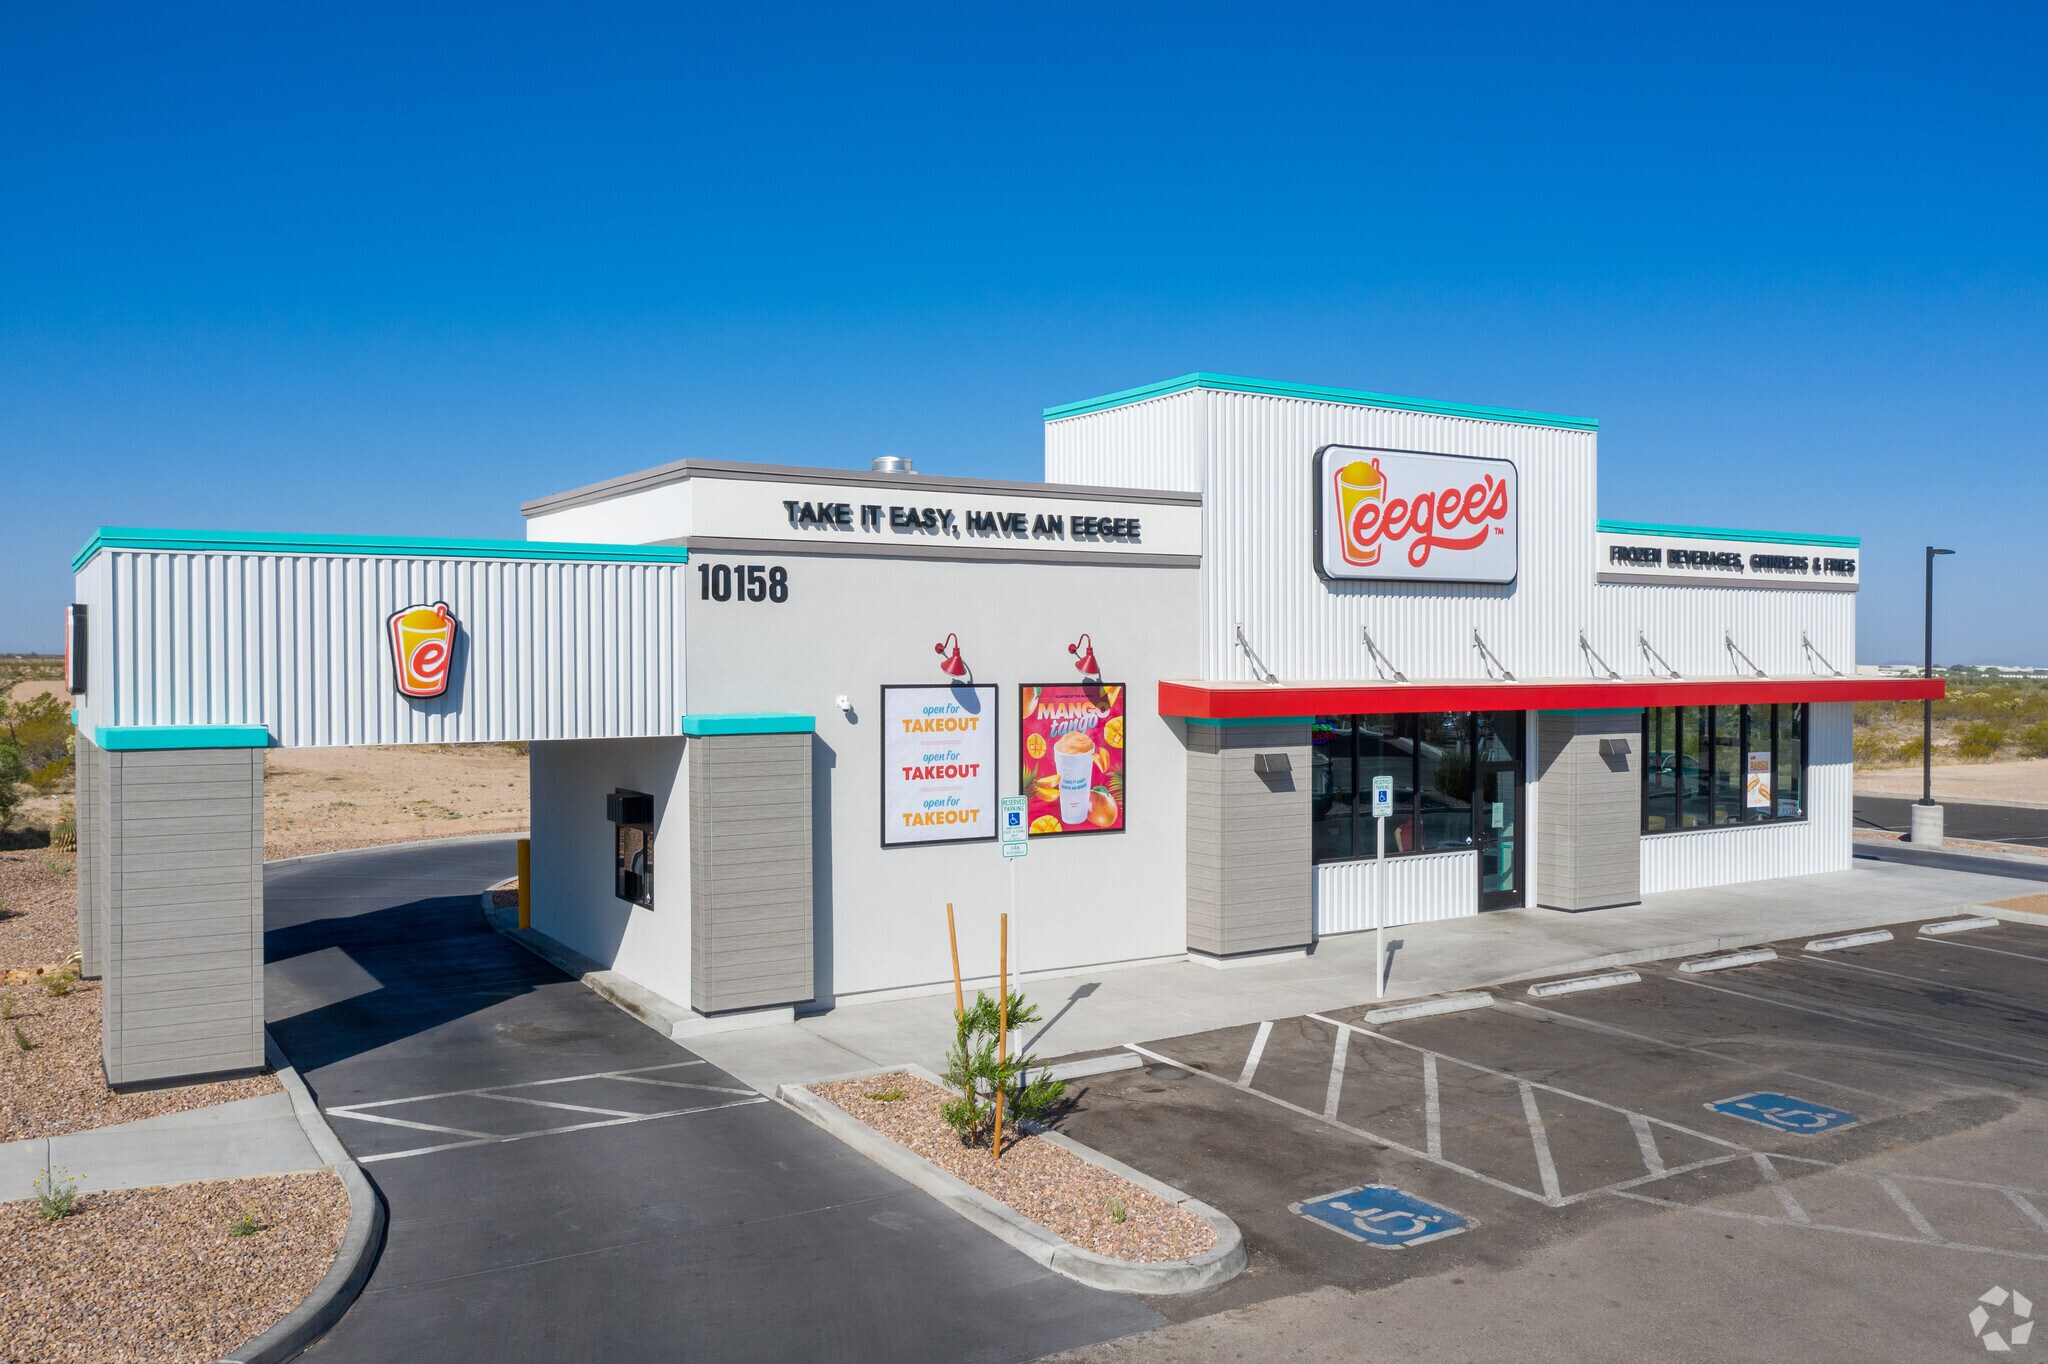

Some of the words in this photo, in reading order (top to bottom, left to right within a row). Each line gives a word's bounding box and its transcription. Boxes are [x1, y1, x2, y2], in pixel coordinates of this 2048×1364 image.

[782, 500, 851, 525] TAKE
[860, 504, 882, 526] IT
[888, 506, 959, 533] EASY,
[965, 510, 1027, 533] HAVE
[1031, 513, 1063, 534] AN
[1070, 515, 1141, 537] EEGEE
[1352, 473, 1509, 568] eegee's
[1609, 545, 1662, 563] FROZEN
[1666, 549, 1744, 571] BEVERAGES,
[1749, 554, 1809, 570] GRINDERS
[1812, 557, 1822, 571] &
[1823, 557, 1856, 573] FRIES
[697, 563, 789, 604] 10158
[412, 643, 447, 678] e
[922, 705, 945, 717] open
[946, 703, 960, 714] for
[1037, 701, 1111, 720] MANGO
[902, 717, 980, 733] TAKEOUT
[1049, 713, 1099, 738] tango
[922, 752, 945, 764] open
[946, 750, 960, 761] for
[902, 764, 980, 781] TAKEOUT
[923, 798, 945, 810] open
[946, 796, 960, 807] for
[902, 809, 980, 827] TAKEOUT
